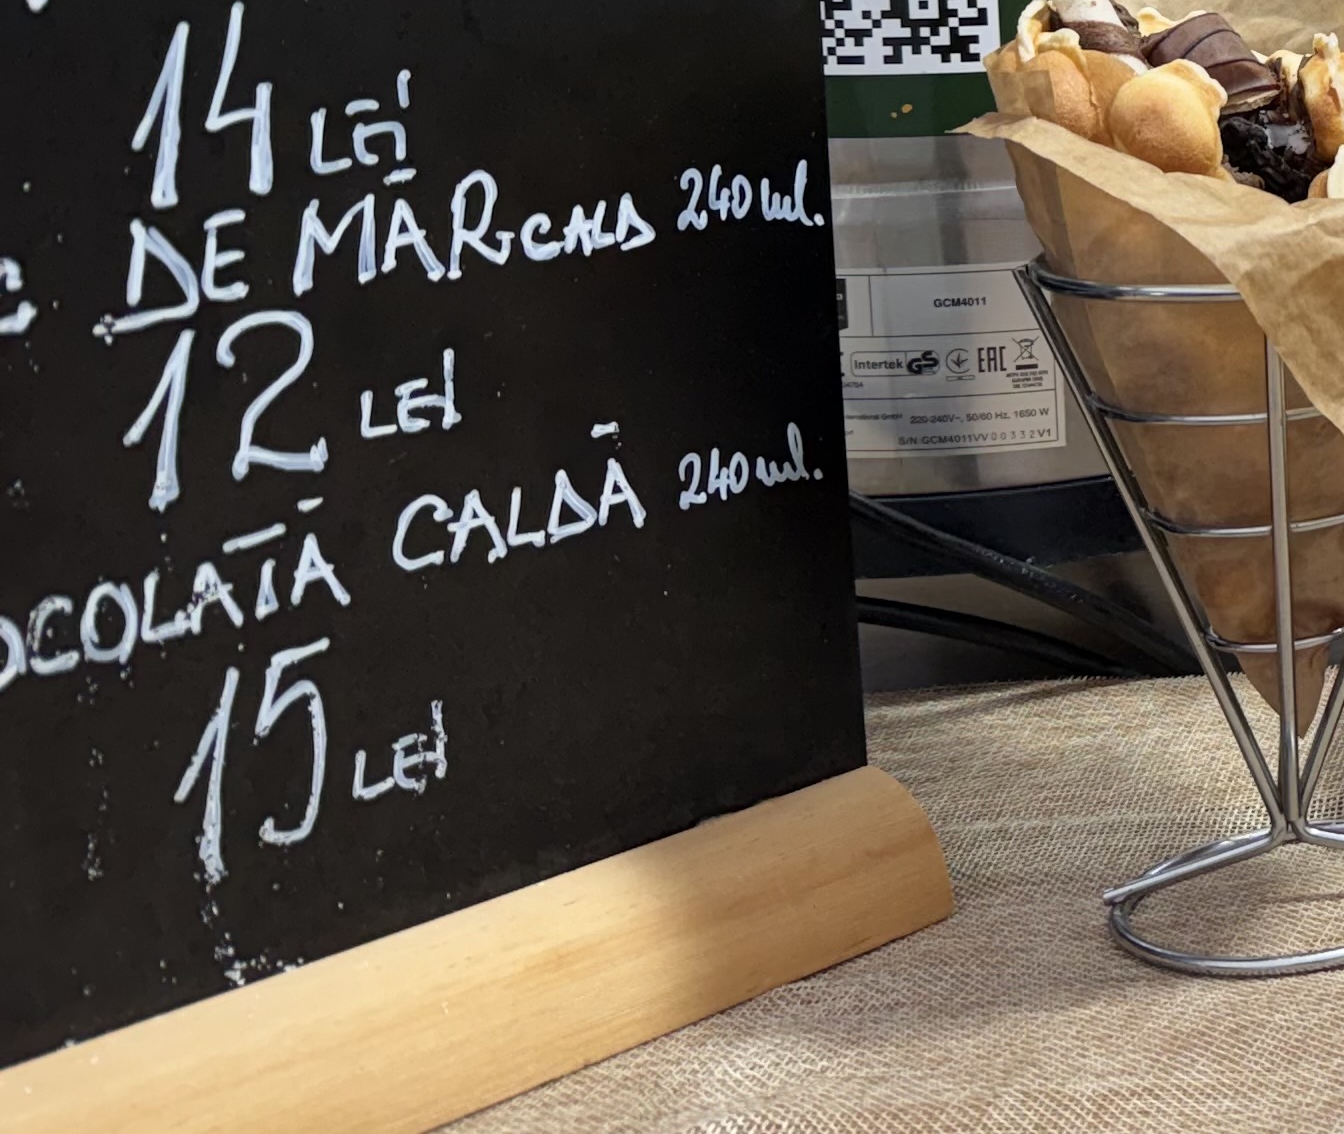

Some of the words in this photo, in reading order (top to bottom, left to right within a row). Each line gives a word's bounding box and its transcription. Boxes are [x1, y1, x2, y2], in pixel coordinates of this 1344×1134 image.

[131, 1, 274, 209] 14
[676, 163, 753, 231] 240
[933, 297, 987, 308] GCM4011
[854, 358, 904, 370] Intertek
[905, 350, 940, 375] GS
[122, 310, 329, 512] 12
[1039, 407, 1050, 416] W
[678, 447, 750, 511] 240
[173, 637, 331, 885] 15
